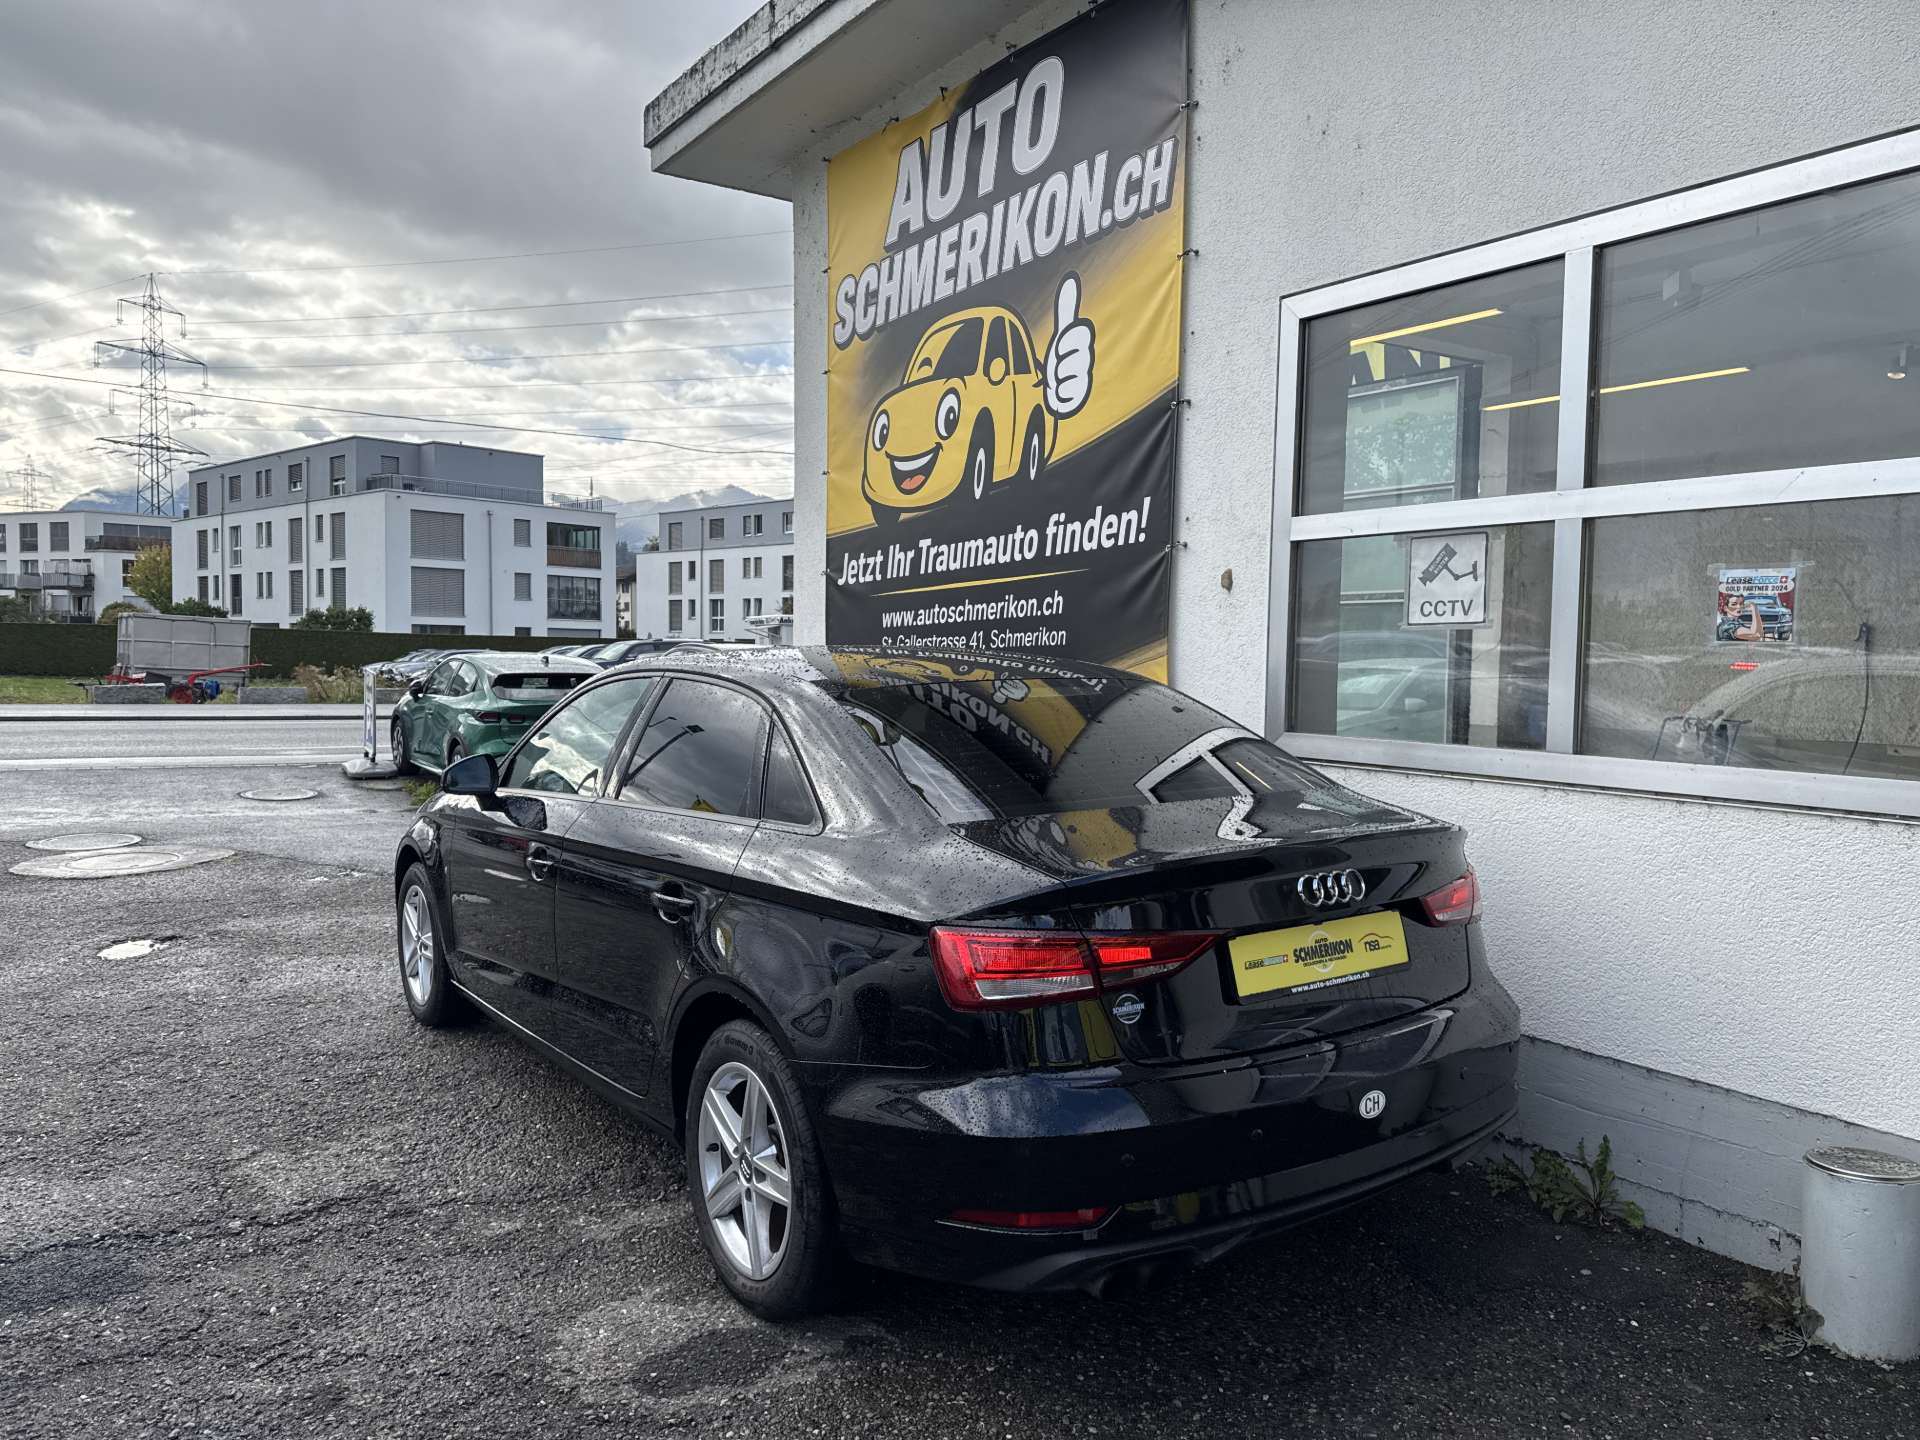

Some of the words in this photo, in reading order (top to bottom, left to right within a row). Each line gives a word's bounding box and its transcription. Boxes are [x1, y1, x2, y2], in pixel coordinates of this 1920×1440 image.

[885, 55, 1064, 248] AUTO
[834, 136, 1179, 347] SCHMERIKON.CH
[837, 550, 882, 586] Jetzt
[887, 551, 914, 579] Ihr
[918, 525, 1039, 574] Traumauto
[1044, 496, 1151, 557] finden!
[881, 590, 1064, 628] www.autoschmerikon.ch
[1420, 599, 1474, 617] CCTV
[969, 632, 986, 651] 41,
[990, 628, 1066, 649] Schmerikon
[1293, 938, 1354, 964] SCHMERIKON
[1290, 971, 1370, 993] www.auto-schmerikon.ch
[1364, 1094, 1380, 1115] CH
